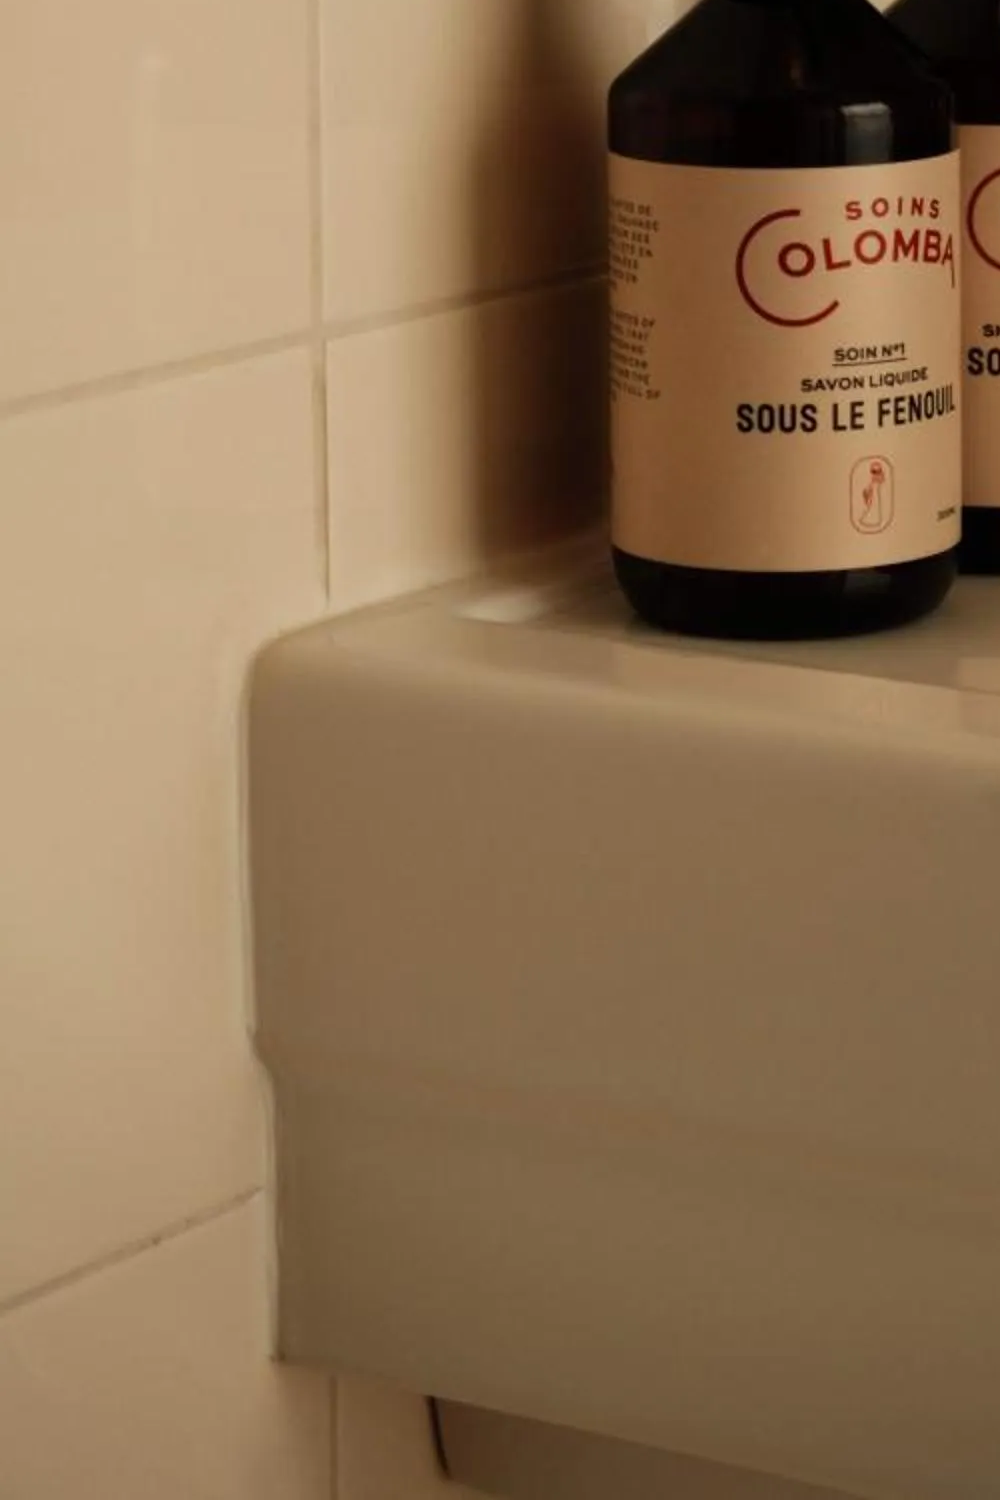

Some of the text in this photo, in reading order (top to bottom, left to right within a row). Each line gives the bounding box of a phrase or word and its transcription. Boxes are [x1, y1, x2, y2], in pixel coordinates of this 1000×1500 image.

[845, 196, 940, 220] SOINS
[735, 209, 955, 327] COLOMBA
[834, 347, 877, 362] SOIN
[801, 367, 928, 393] SAVON LIQUIDE
[736, 385, 956, 434] SOUS LE FENOUIL
